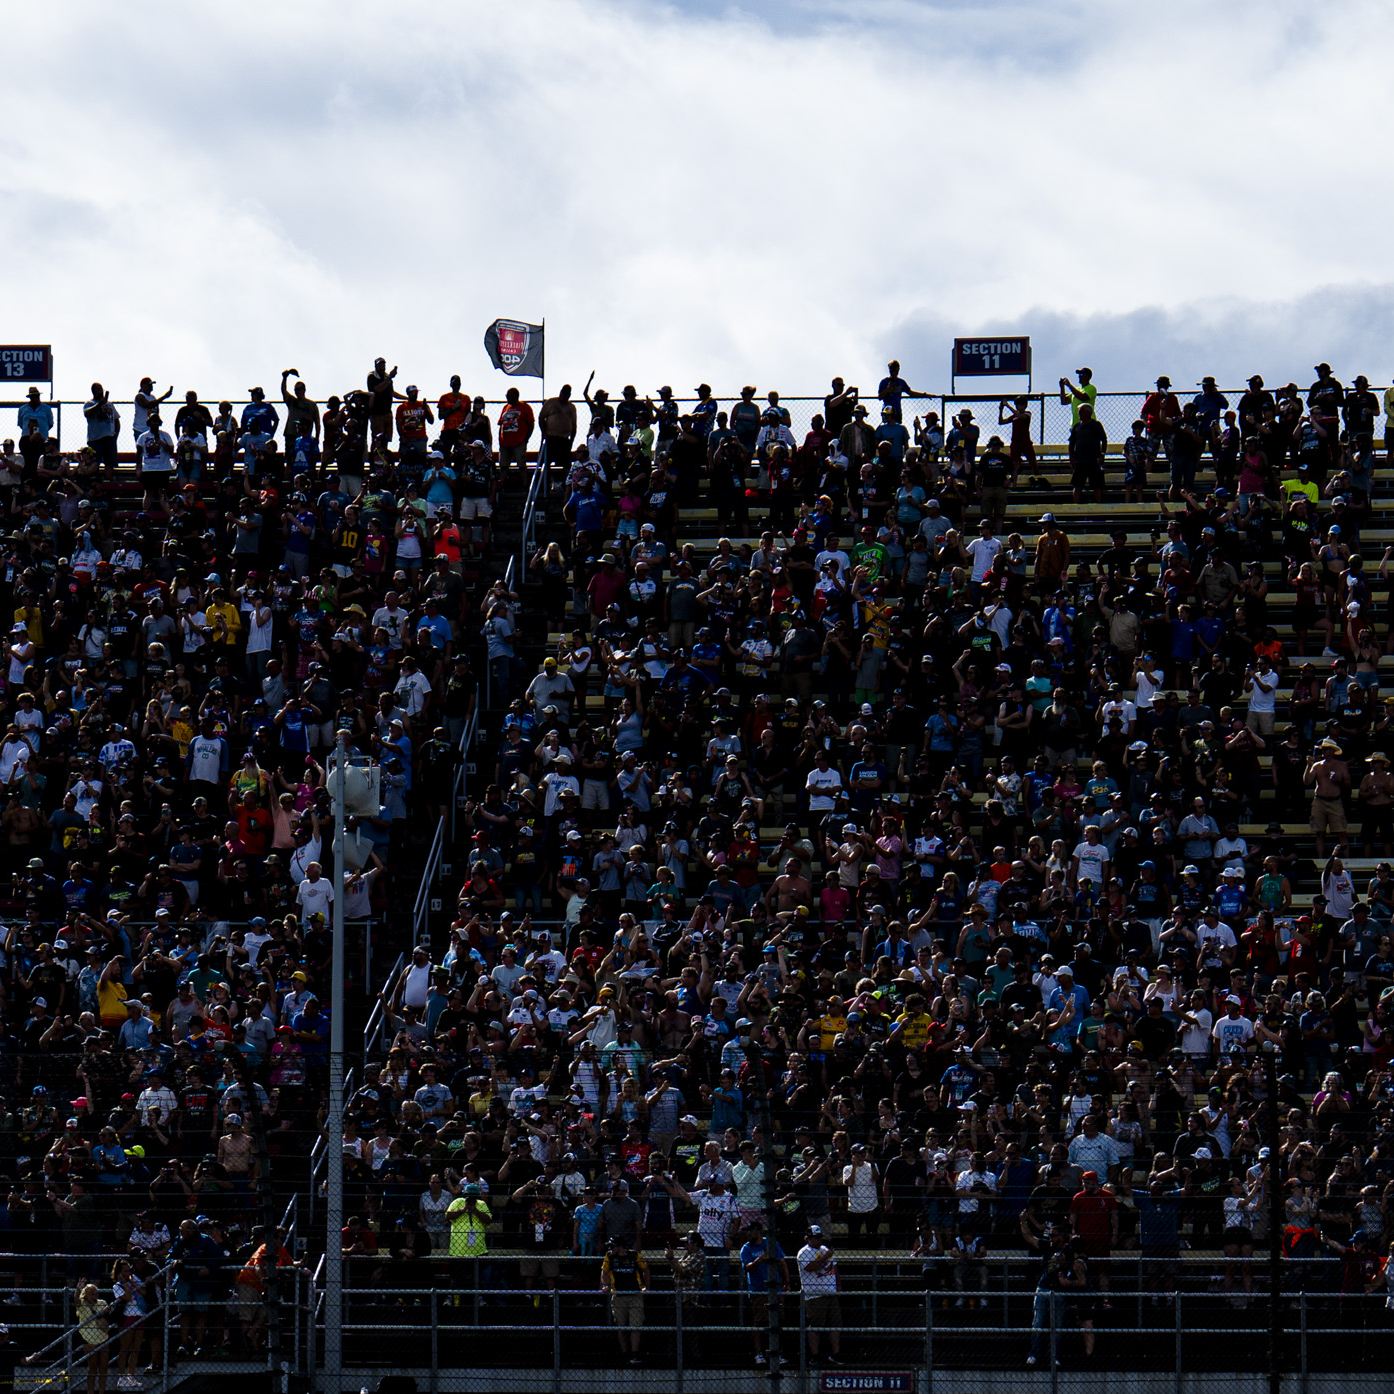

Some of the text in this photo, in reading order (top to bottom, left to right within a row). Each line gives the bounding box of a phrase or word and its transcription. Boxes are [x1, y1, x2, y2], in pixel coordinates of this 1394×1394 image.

[961, 342, 1022, 355] SECTION
[982, 354, 1000, 369] 11
[4, 362, 25, 377] 13
[825, 1376, 884, 1389] SECTION
